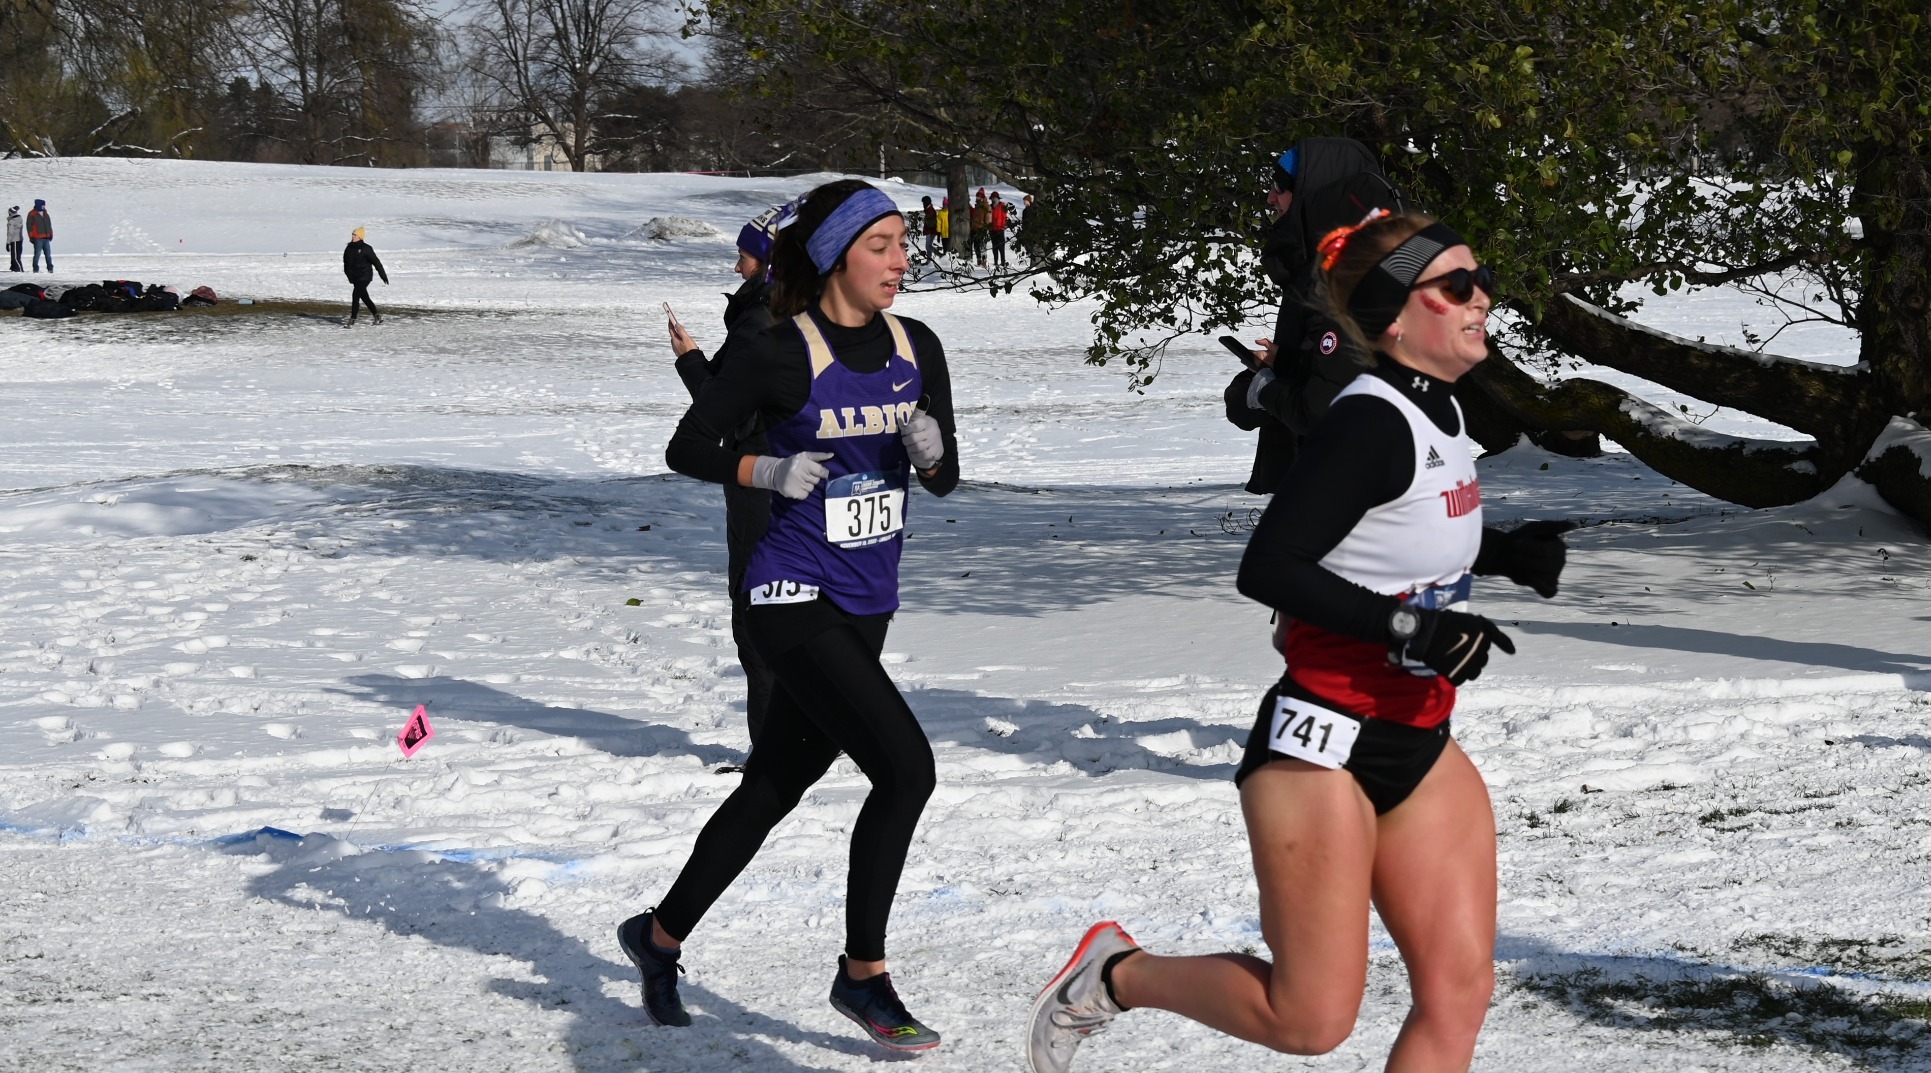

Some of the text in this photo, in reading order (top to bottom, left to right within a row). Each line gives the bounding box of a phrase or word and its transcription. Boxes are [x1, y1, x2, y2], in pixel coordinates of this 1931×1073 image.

[816, 400, 918, 439] ALBIO
[847, 494, 891, 537] 375
[1276, 708, 1333, 753] 741
